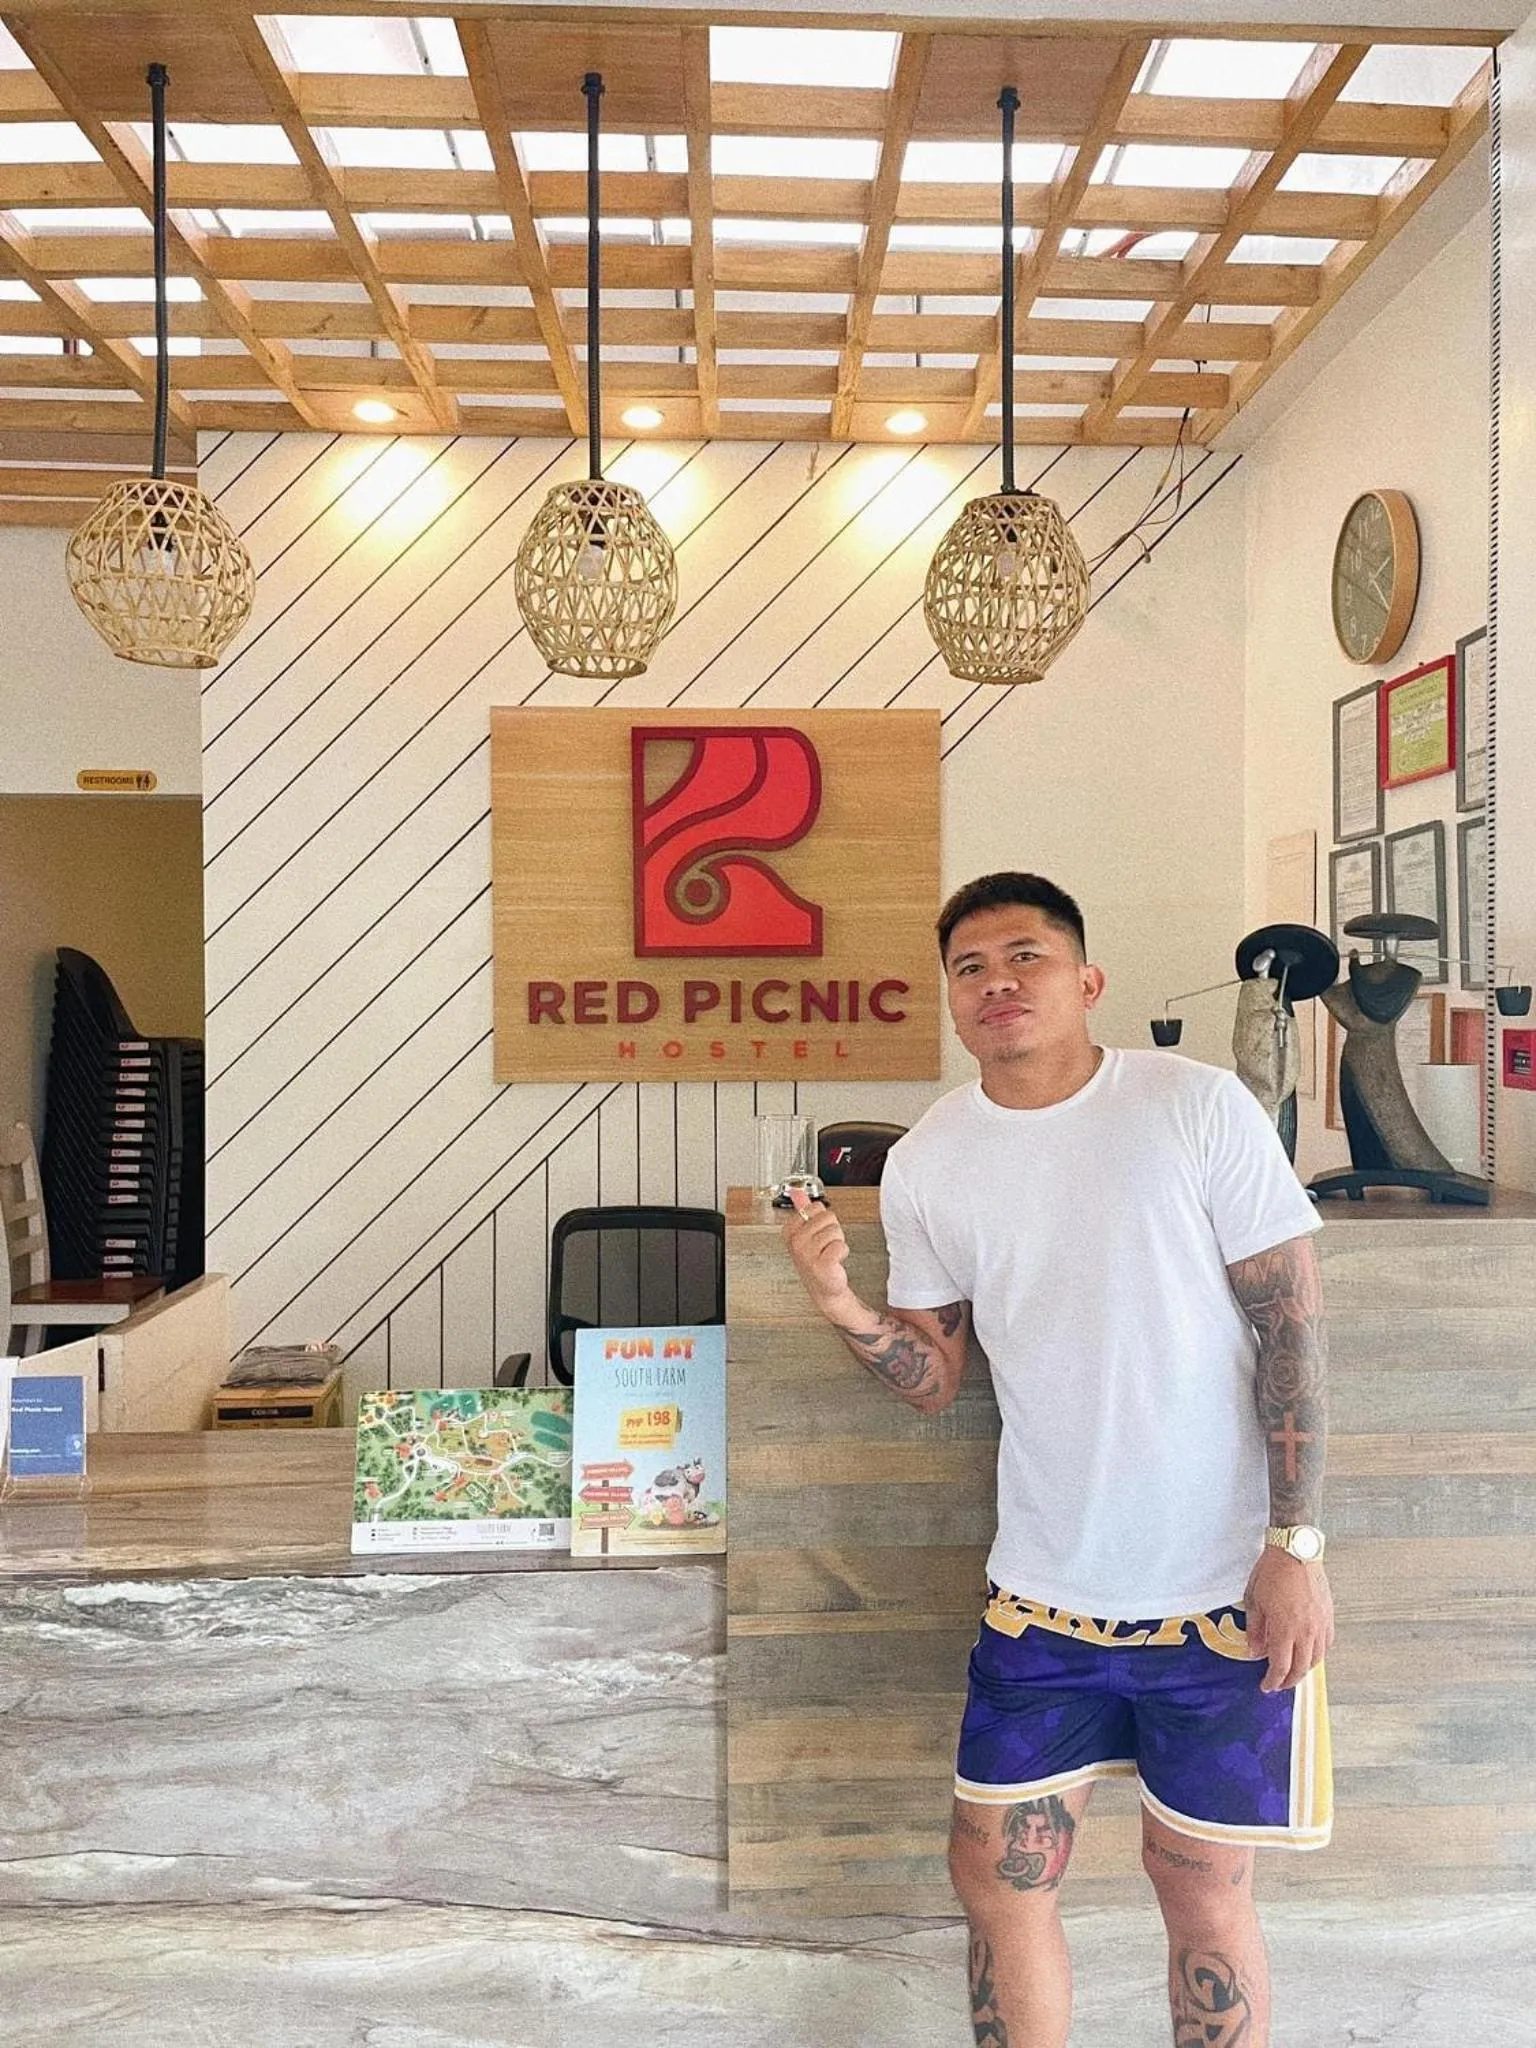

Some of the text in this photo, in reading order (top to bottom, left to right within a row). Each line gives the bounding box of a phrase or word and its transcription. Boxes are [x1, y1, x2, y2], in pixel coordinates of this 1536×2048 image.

[527, 979, 909, 1025] RED PICNIC
[618, 1041, 850, 1059] HOSTEL
[604, 1337, 696, 1360] FUN AT
[614, 1367, 687, 1388] SOUTH FARM
[646, 1410, 672, 1427] 198
